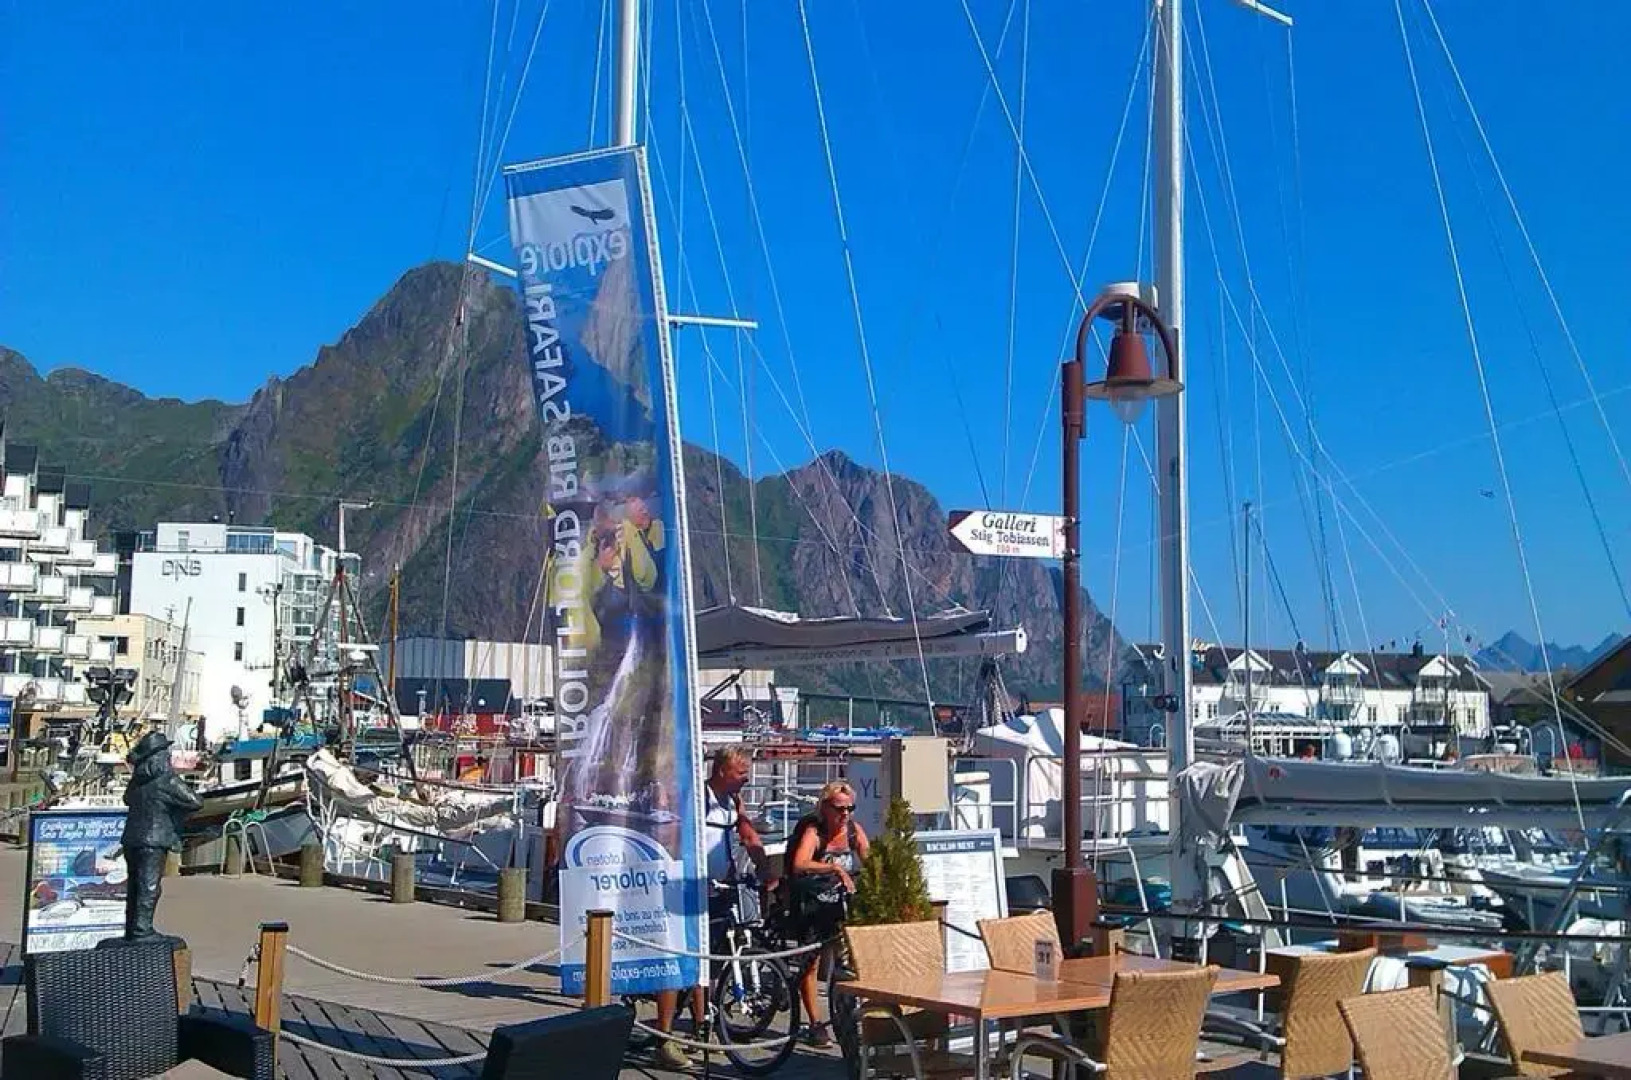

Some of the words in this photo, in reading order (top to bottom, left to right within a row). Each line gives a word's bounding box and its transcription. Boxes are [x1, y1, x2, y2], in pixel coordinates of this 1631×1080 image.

[982, 513, 1037, 532] Galleri
[970, 529, 993, 545] Stig
[996, 531, 1050, 547] Tobiassen
[161, 556, 202, 581] DNB
